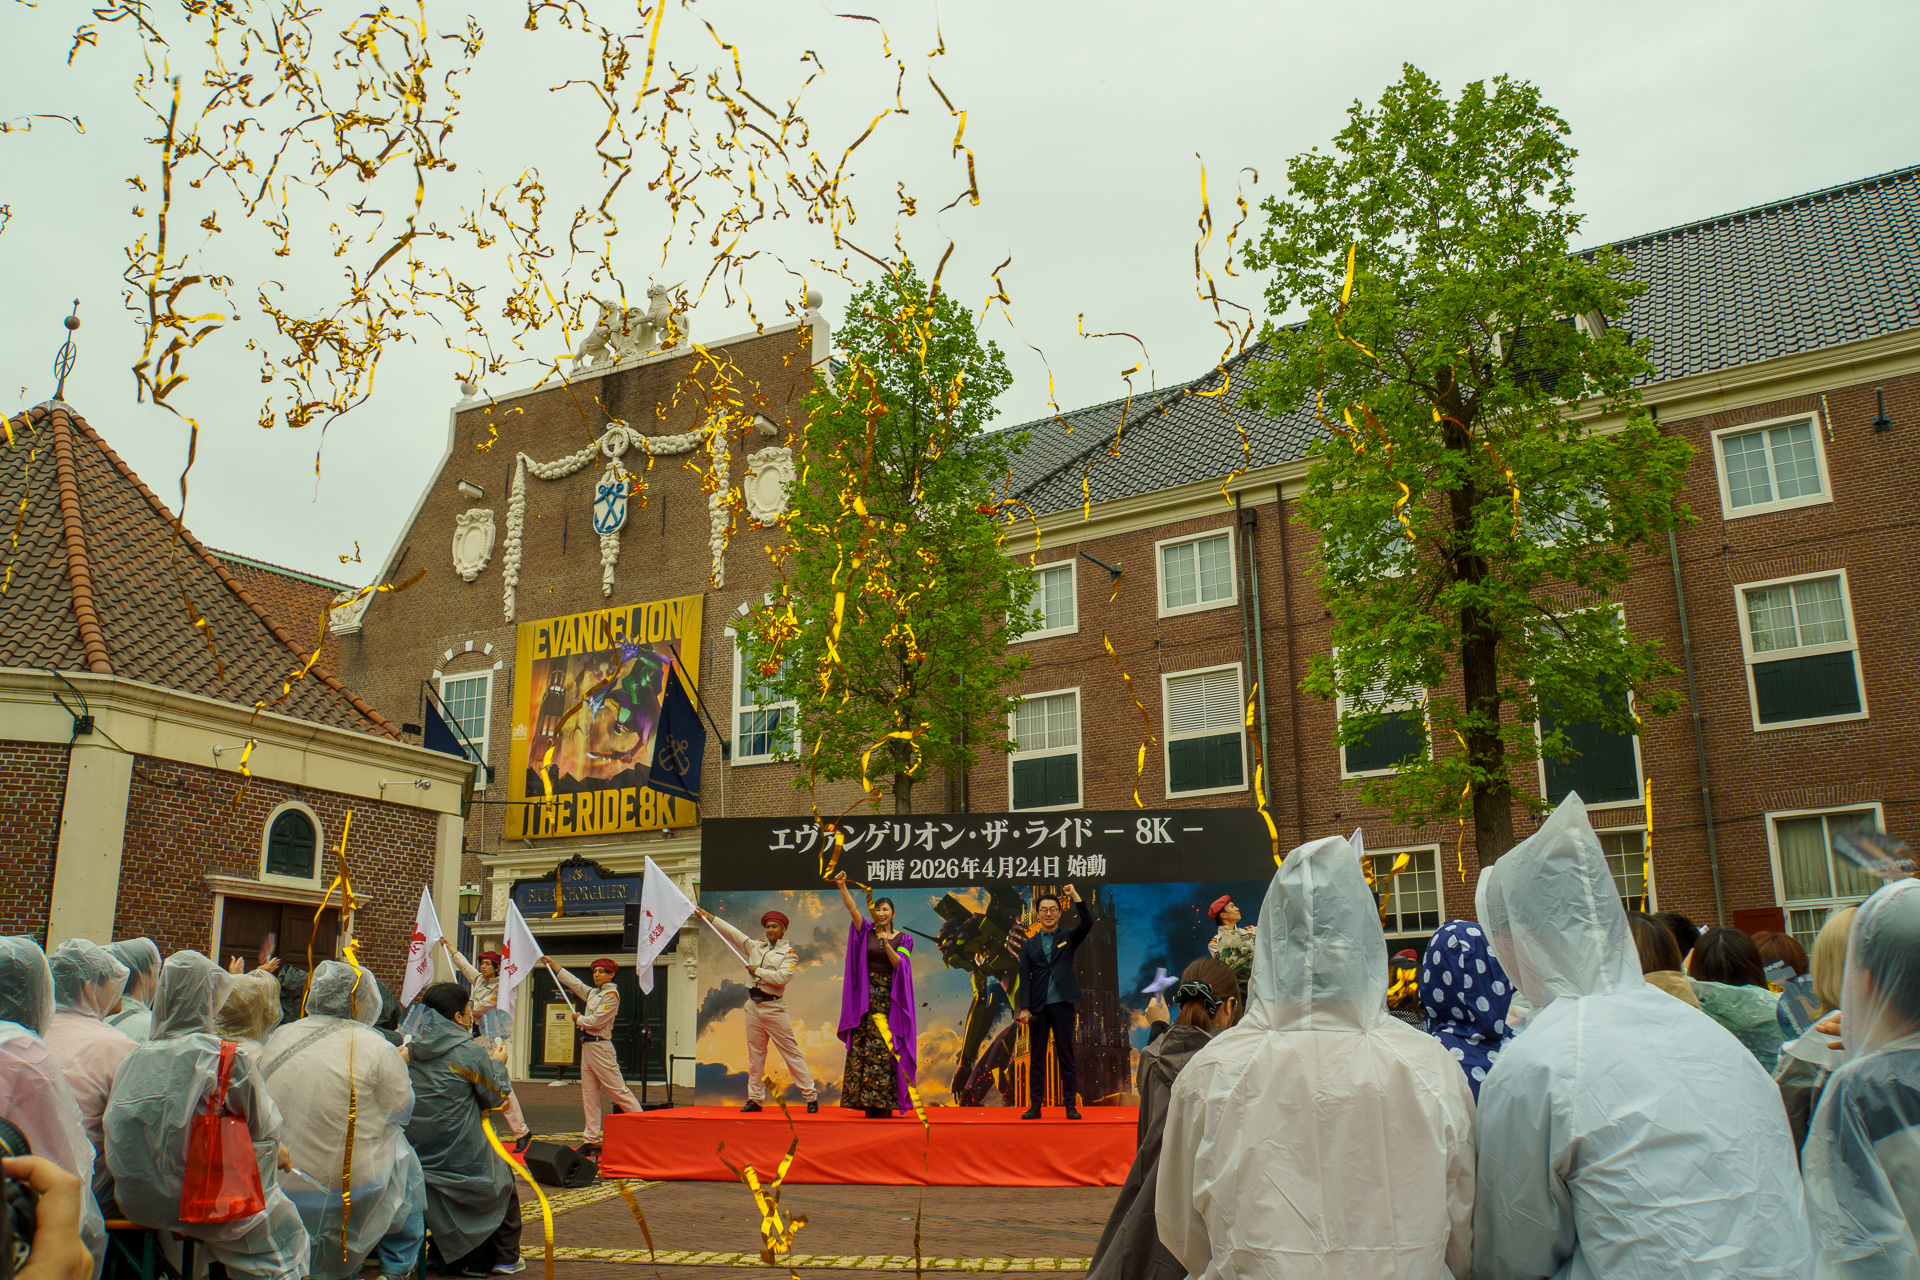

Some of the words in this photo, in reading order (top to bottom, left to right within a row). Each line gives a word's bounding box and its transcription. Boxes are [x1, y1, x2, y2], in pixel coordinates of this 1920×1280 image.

[532, 602, 683, 660] EVANGELION
[576, 786, 637, 833] RIDE
[639, 785, 676, 828] 8K
[1135, 817, 1175, 844] 8K
[866, 859, 905, 882] 西暦
[909, 855, 1060, 880] 2026年4月24日
[1067, 854, 1106, 877] 始動
[528, 888, 549, 903] BLUE
[550, 886, 589, 902] ACHOR
[589, 884, 629, 900] GALLERY
